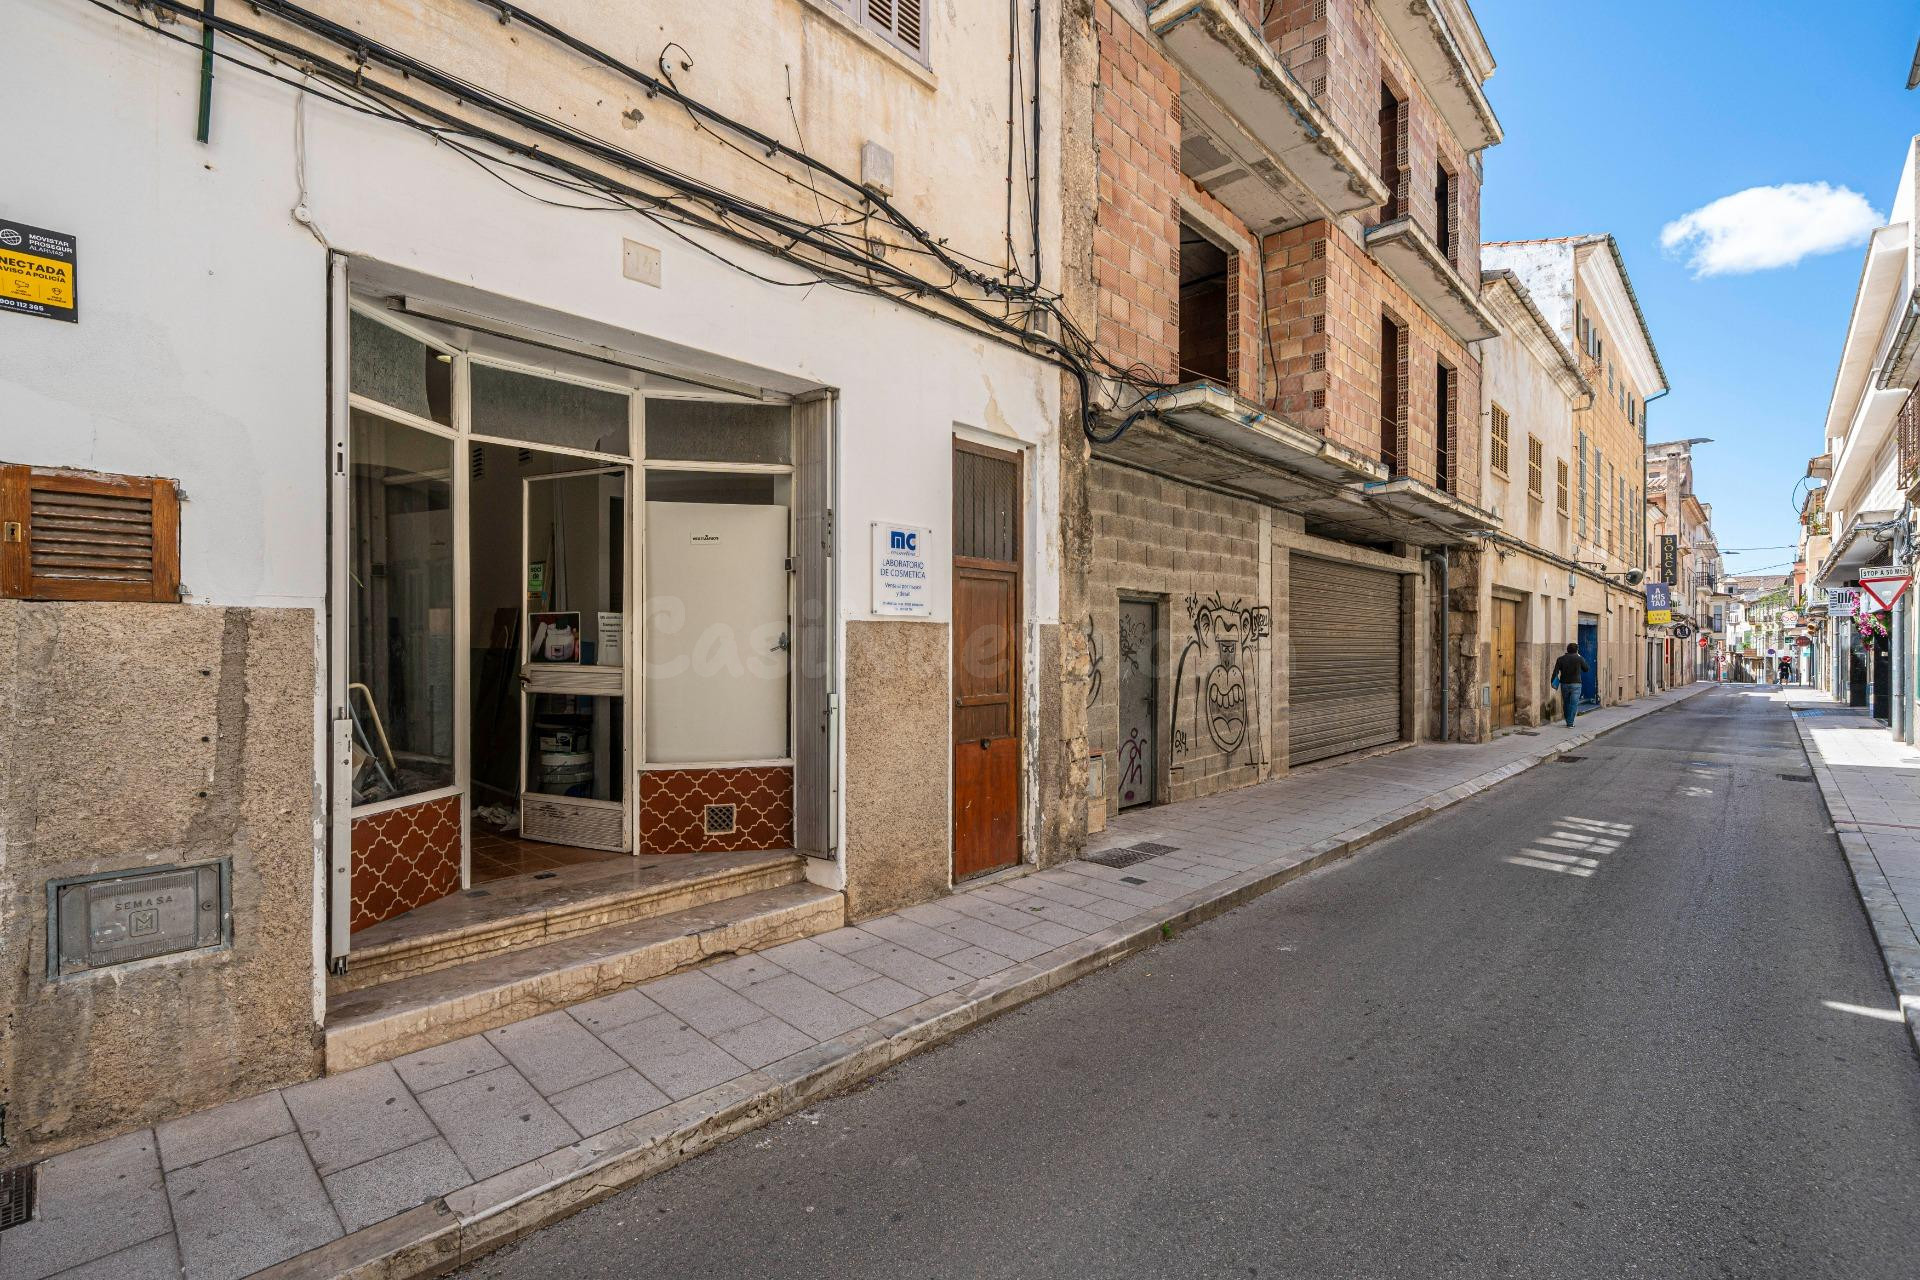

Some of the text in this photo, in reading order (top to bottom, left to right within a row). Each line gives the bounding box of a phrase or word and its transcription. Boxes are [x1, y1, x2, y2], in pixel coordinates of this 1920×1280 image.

[29, 234, 69, 247] MOVISTAR
[29, 239, 72, 253] PROSEGUR
[29, 245, 63, 256] ALARMAS
[16, 301, 28, 309] 112
[883, 560, 924, 570] LABORATORIO
[880, 568, 889, 577] DE
[1863, 568, 1878, 577] STOP
[1651, 593, 1666, 601] MIS
[1651, 599, 1666, 607] TAD
[115, 895, 174, 912] SEMASA
